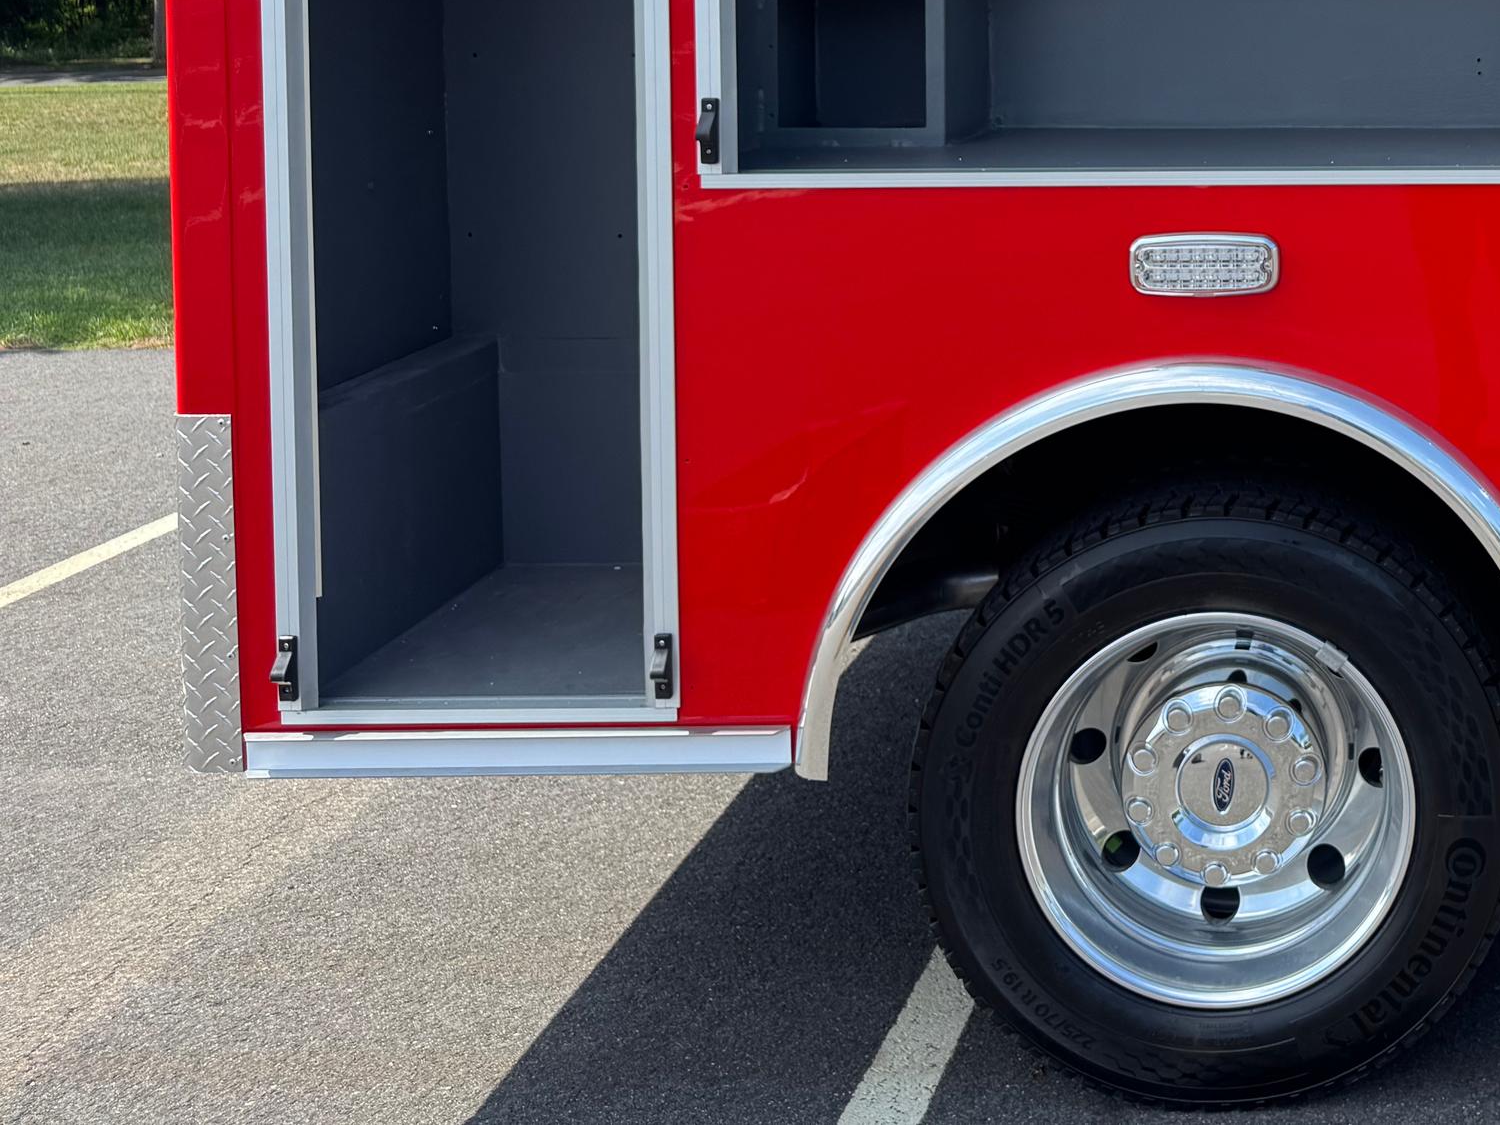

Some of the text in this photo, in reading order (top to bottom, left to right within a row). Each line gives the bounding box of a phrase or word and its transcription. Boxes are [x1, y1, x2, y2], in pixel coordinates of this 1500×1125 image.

[954, 598, 1065, 748] Conti HDR 5
[1216, 769, 1232, 802] Ford
[1347, 836, 1487, 1041] Continental
